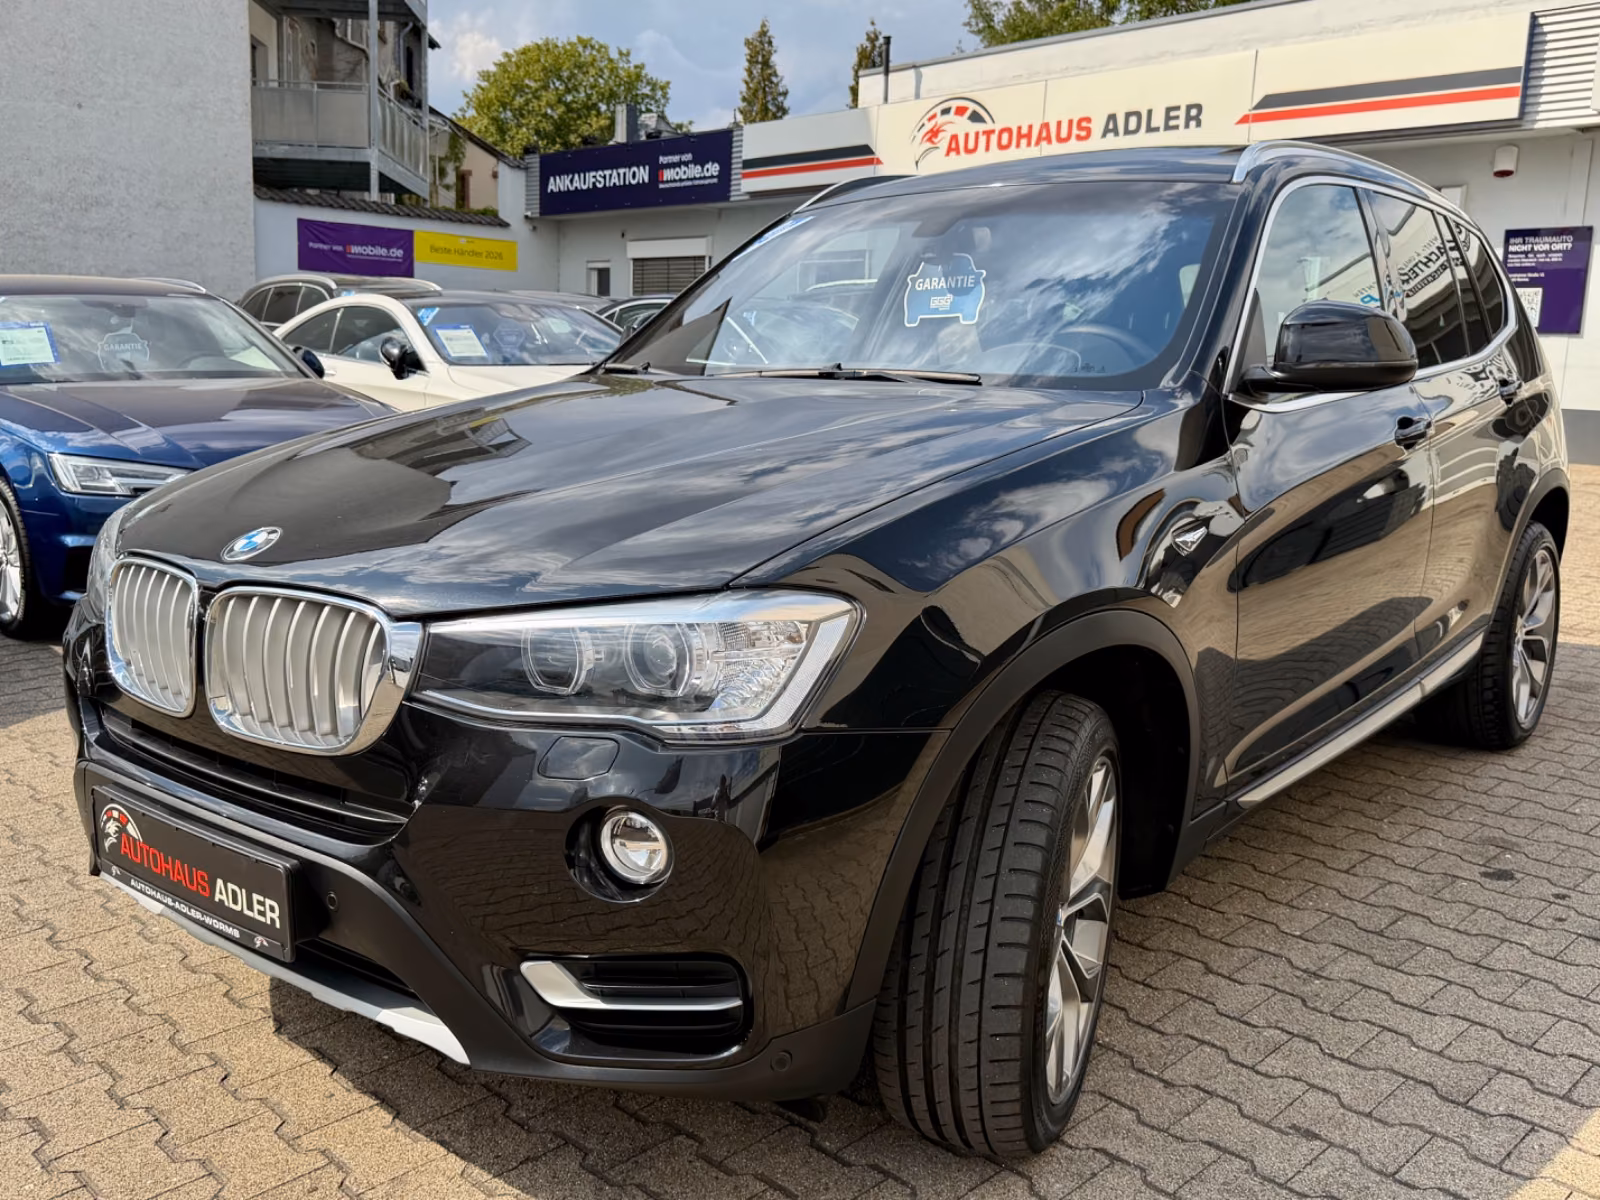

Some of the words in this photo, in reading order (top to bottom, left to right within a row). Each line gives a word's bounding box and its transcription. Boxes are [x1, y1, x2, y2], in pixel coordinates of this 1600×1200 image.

[945, 116, 1092, 157] AUTOHAUS
[1101, 103, 1203, 139] ADLER
[547, 165, 650, 193] ANKAUFSTATION
[663, 161, 720, 182] mobile.de
[1508, 244, 1533, 252] NICHT
[1551, 242, 1573, 251] ORT?
[1525, 235, 1574, 244] TRAUMAUTO
[350, 244, 404, 258] mobile.de
[430, 244, 452, 254] Beste
[454, 247, 483, 258] Händler
[915, 275, 976, 290] GARANTIE
[104, 343, 142, 351] GARANTIE
[120, 832, 211, 898] AUTOHAUS
[214, 877, 281, 929] ADLER
[130, 879, 241, 939] AUTOHAUS-ADLER-WORMS
